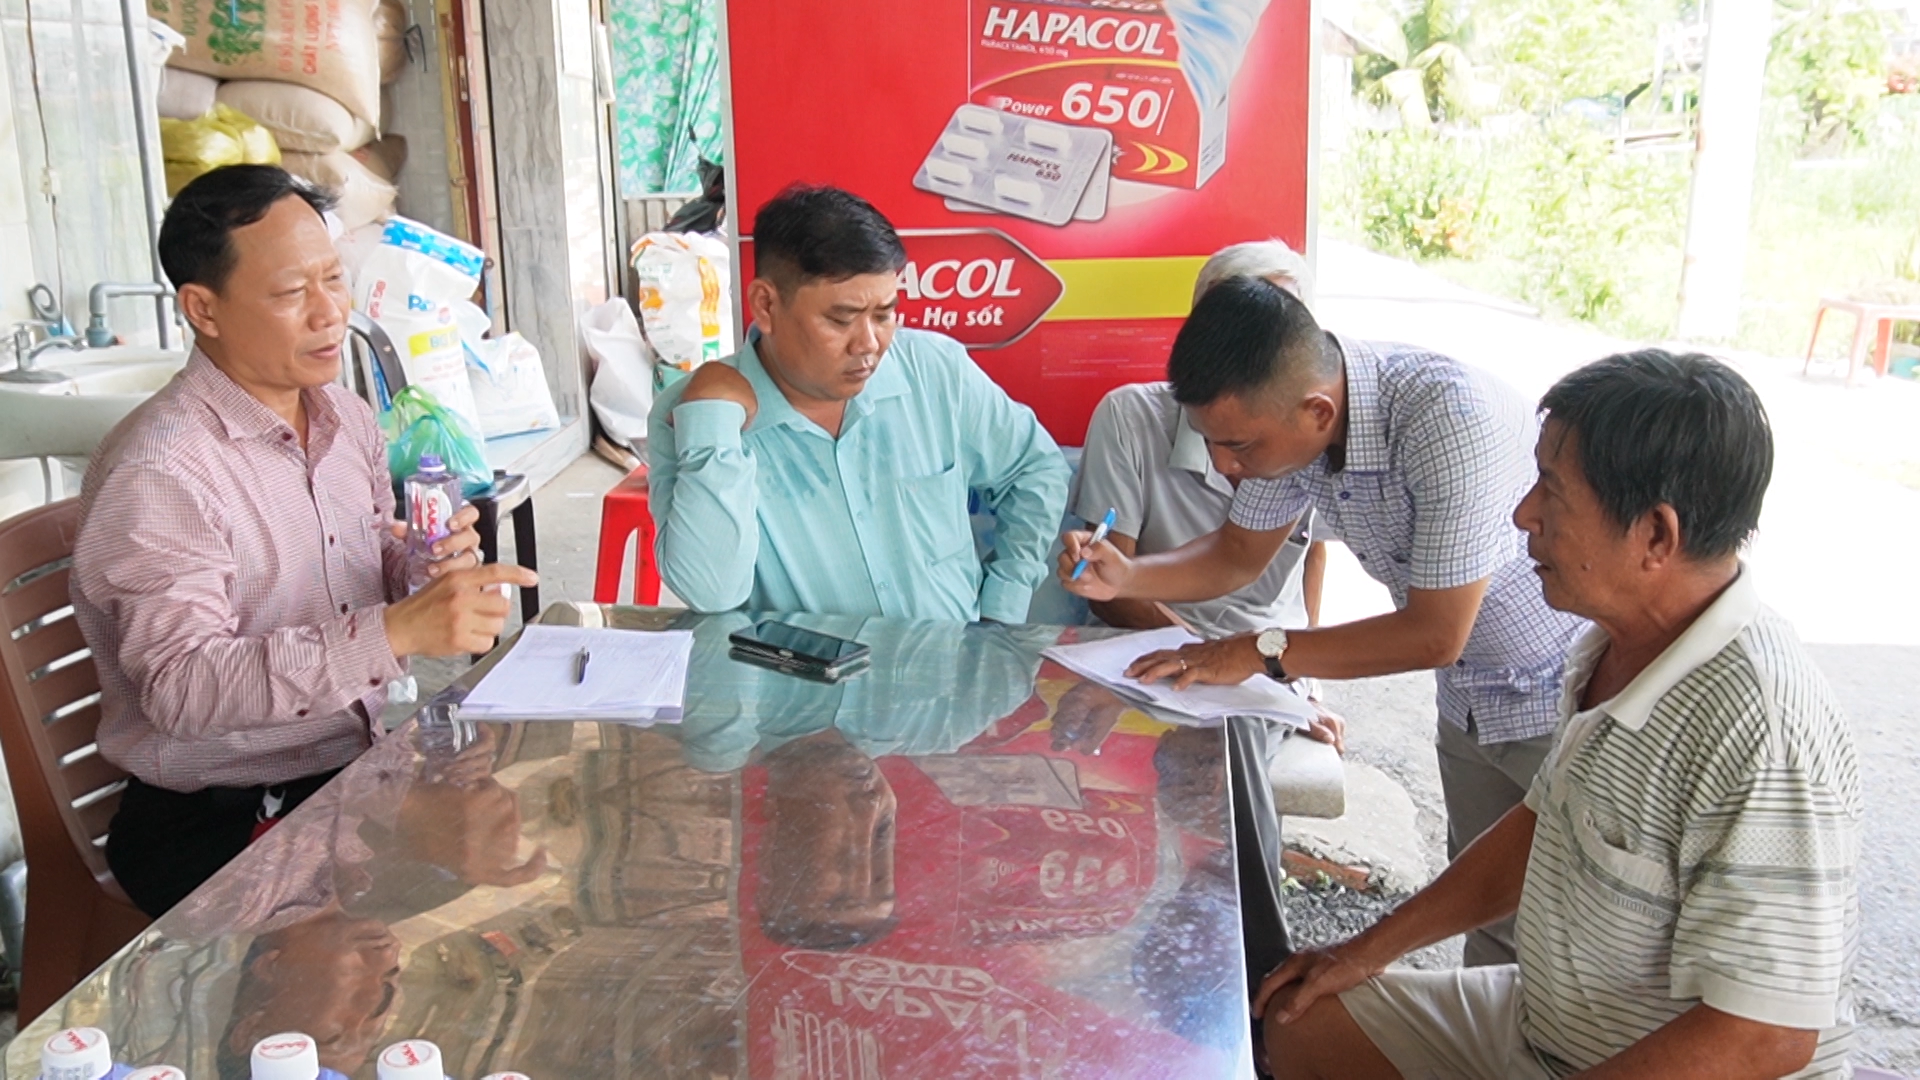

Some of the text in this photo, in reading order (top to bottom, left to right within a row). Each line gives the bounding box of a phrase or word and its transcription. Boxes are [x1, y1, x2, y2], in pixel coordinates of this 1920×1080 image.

[983, 6, 1165, 56] HAPACOL
[1000, 81, 1161, 129] Power 650
[896, 257, 1021, 300] ACOL
[923, 306, 958, 330] Hạ
[965, 303, 1004, 326] sốt
